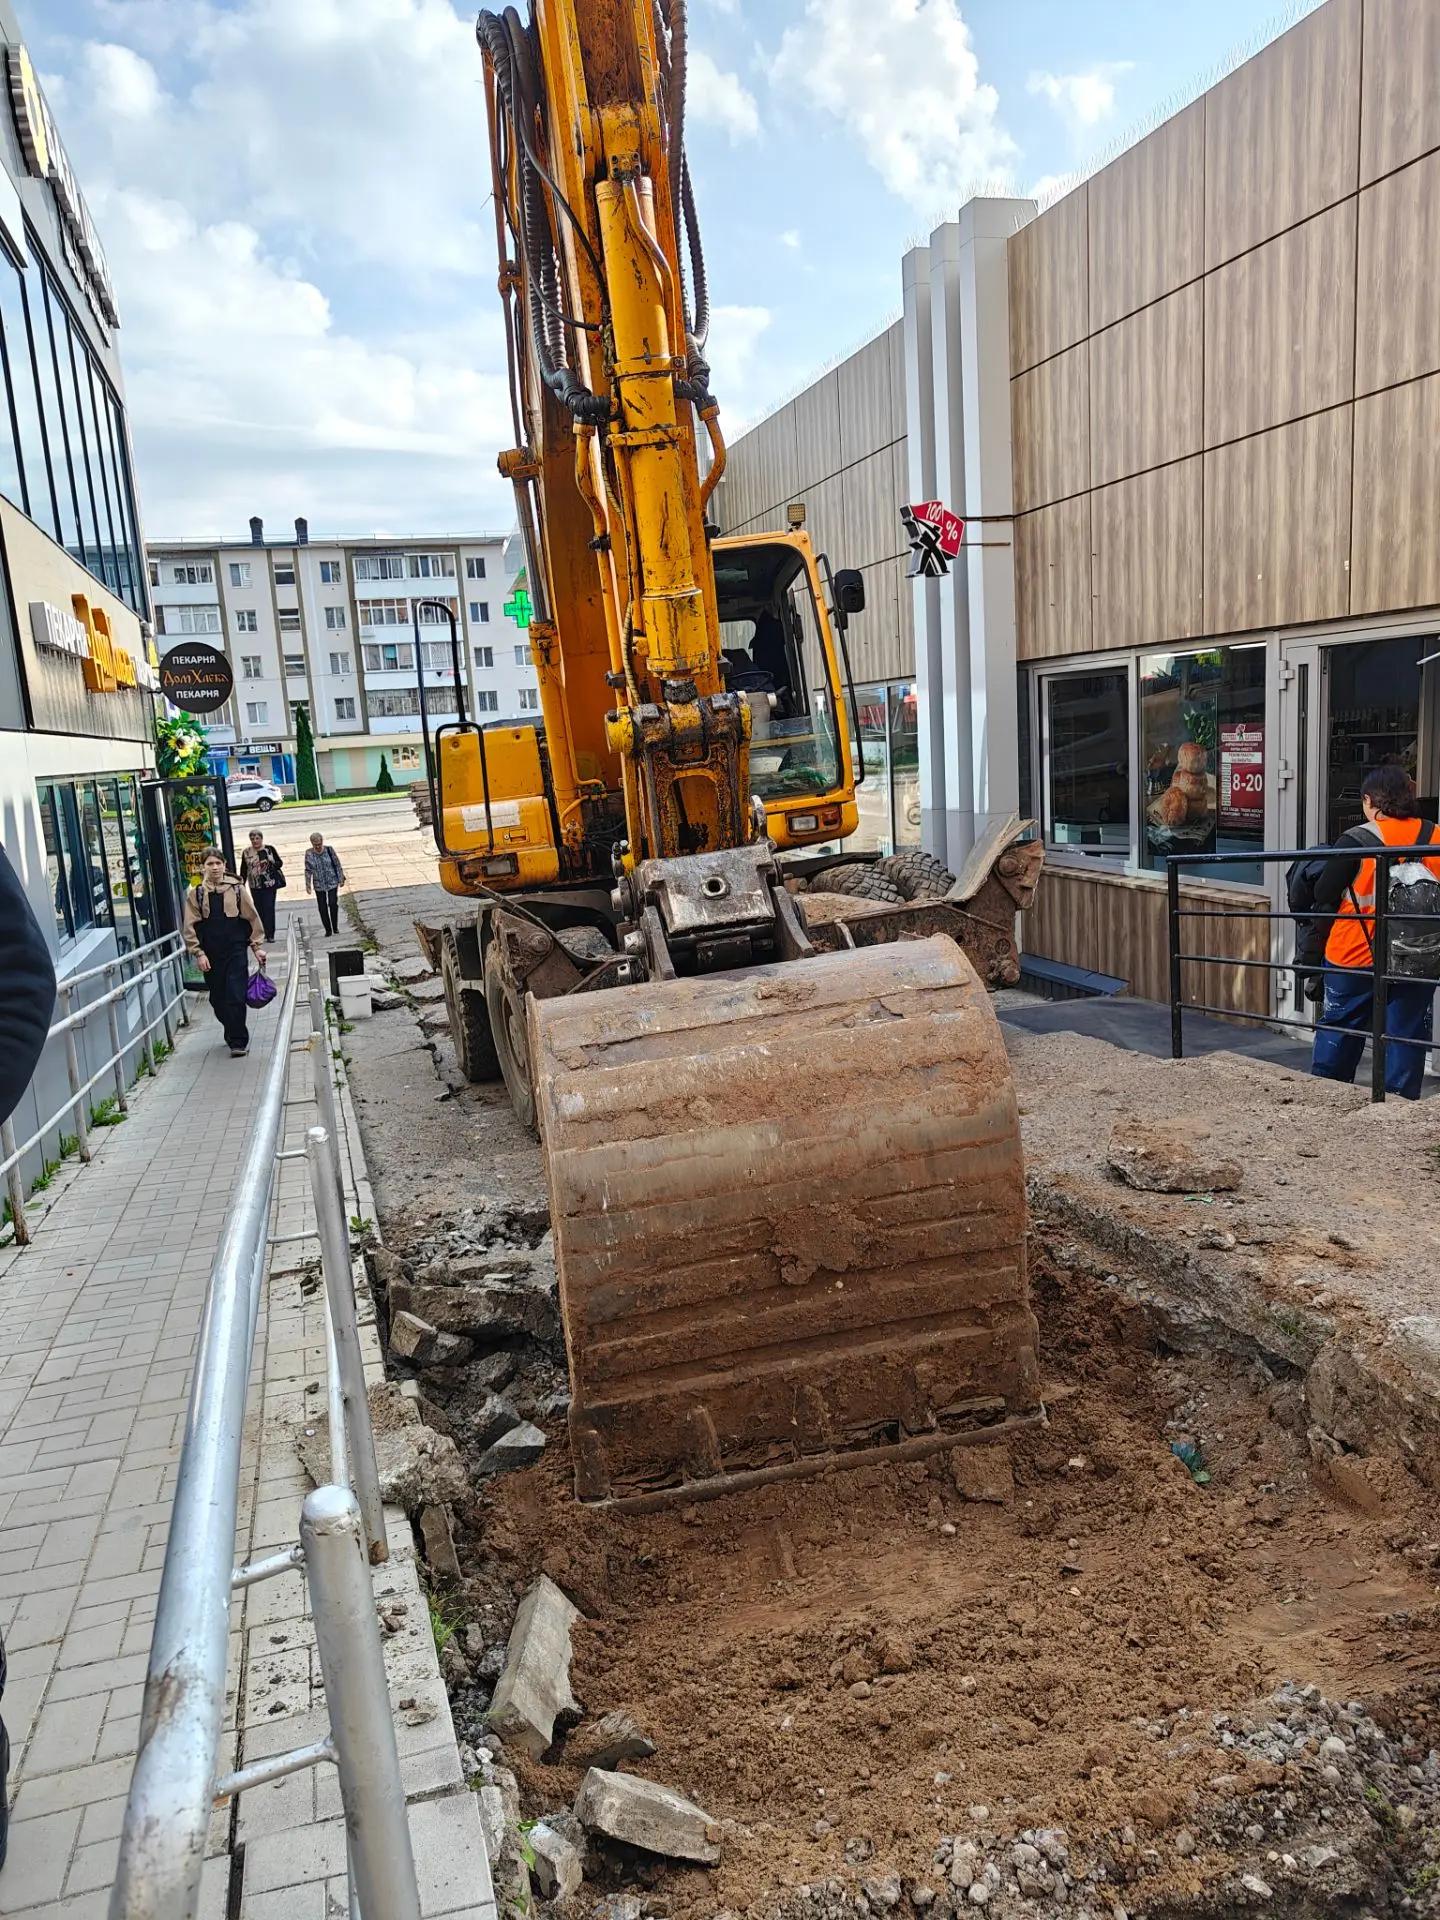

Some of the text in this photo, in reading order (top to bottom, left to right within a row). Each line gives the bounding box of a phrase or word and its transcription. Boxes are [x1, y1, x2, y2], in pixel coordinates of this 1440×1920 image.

[926, 503, 942, 522] 100
[172, 656, 216, 665] ПЕКАРНЯ
[176, 690, 219, 699] ПЕКАРНЯ
[1232, 774, 1263, 792] 8-20
